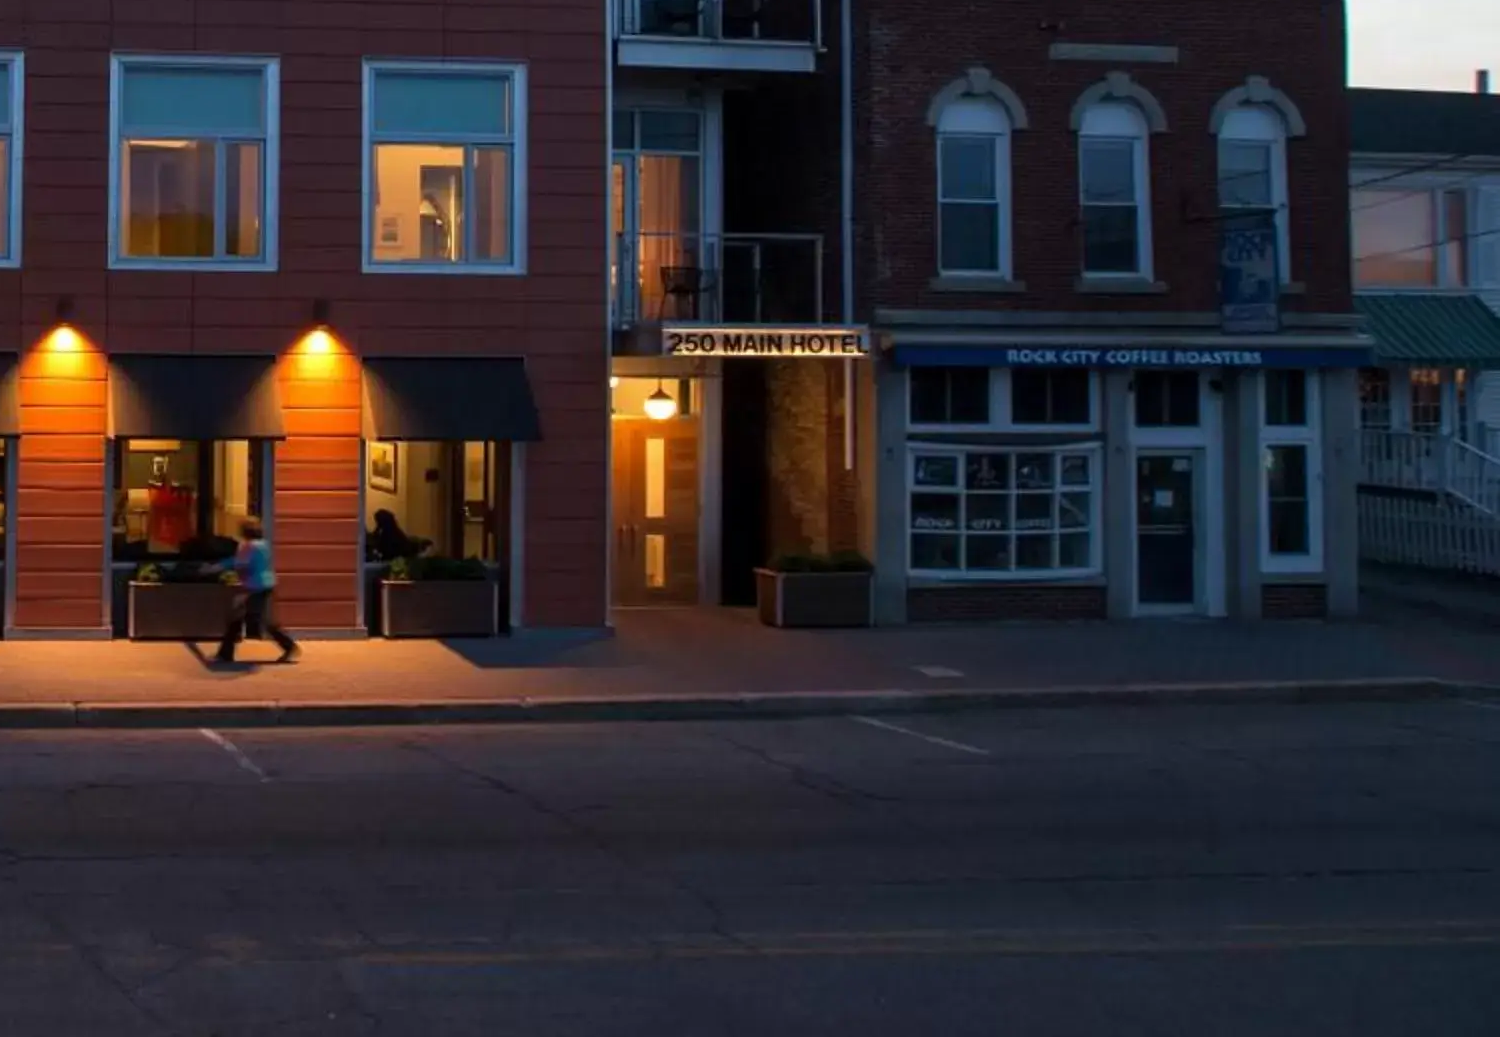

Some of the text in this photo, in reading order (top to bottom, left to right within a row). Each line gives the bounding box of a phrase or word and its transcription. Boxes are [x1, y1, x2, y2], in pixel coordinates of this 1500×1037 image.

[668, 332, 870, 354] 250 MAIN HOTEL
[1006, 349, 1263, 365] ROCK CITY COFFEE ROASTERS
